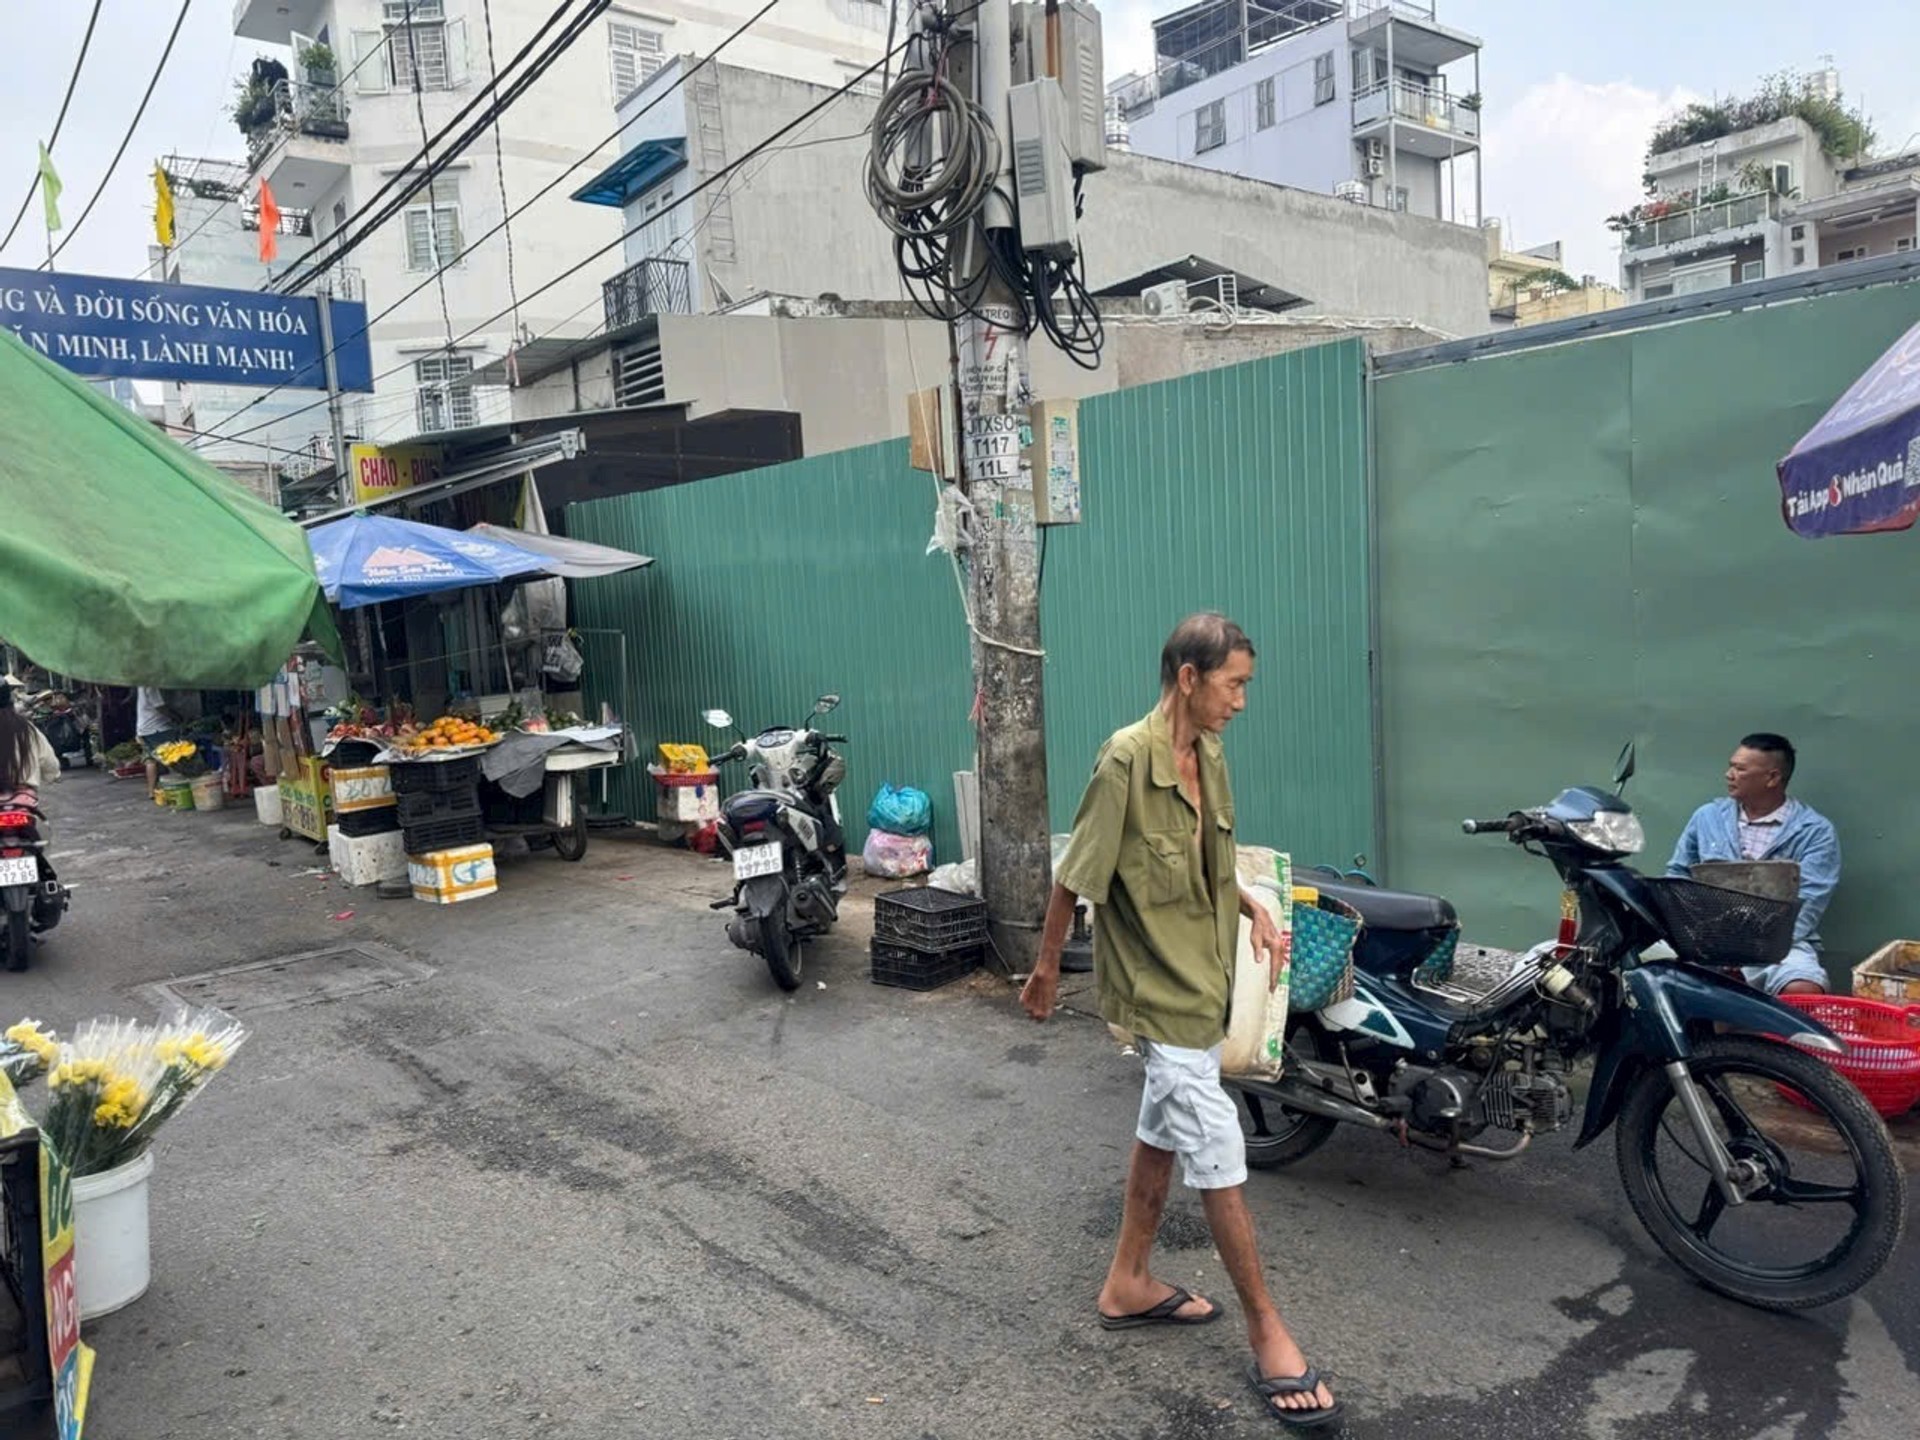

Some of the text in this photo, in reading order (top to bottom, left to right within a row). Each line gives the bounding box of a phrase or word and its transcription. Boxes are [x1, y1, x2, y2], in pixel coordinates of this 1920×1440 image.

[33, 284, 67, 315] VÀ
[76, 289, 126, 321] ĐỜI
[132, 294, 200, 326] SỐNG
[207, 300, 252, 331] VĂN
[259, 306, 309, 336] HÓA
[58, 333, 137, 364] MINH,
[143, 335, 210, 366] LÀNH
[216, 346, 296, 375] MẠNH!
[972, 437, 1010, 457] T117
[978, 460, 1008, 477] 11L
[1809, 488, 1829, 513] App
[1843, 468, 1877, 498] Nhận
